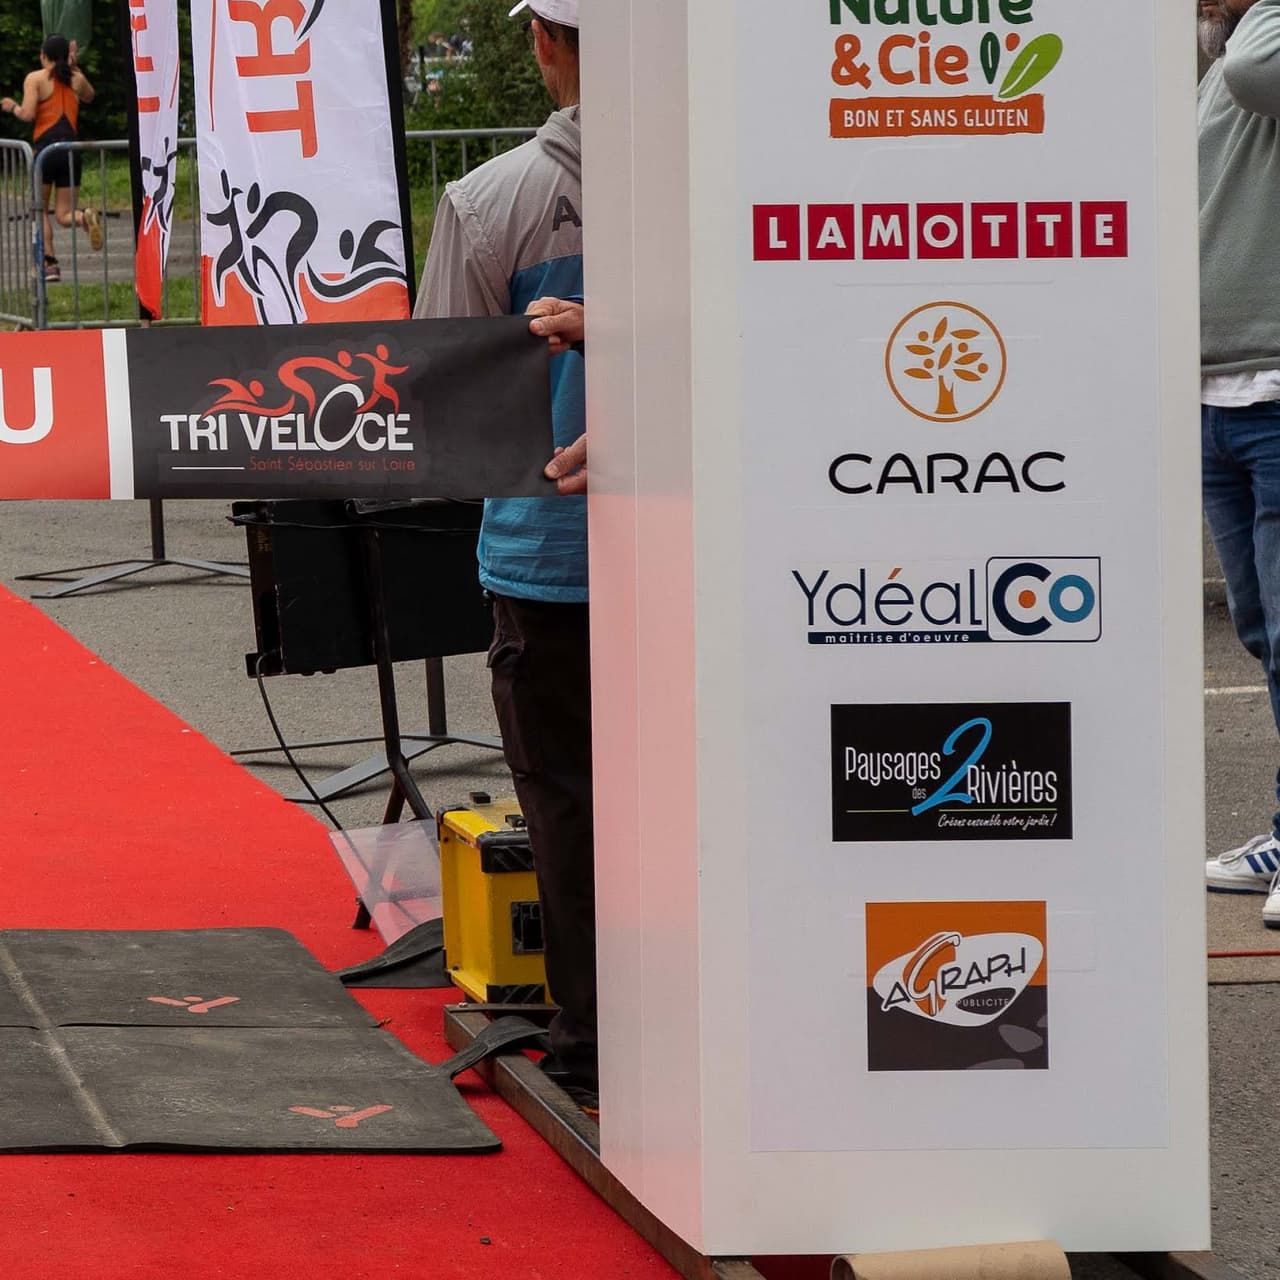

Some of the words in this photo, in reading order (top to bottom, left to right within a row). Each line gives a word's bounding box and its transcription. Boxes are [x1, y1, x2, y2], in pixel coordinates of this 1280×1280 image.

[844, 110, 879, 127] BON
[886, 110, 904, 127] ET
[911, 109, 957, 127] SANS
[964, 109, 1028, 126] GLUTEN
[768, 214, 1113, 248] LAMOTTE
[160, 413, 228, 451] TRI
[240, 383, 414, 451] VELOCE
[250, 456, 281, 470] Saint
[288, 456, 352, 471] Sébastien
[359, 461, 376, 470] sur
[383, 457, 416, 470] Loire
[829, 452, 1065, 494] CARAC
[846, 747, 940, 786] Paysages
[912, 717, 992, 816] 2
[968, 760, 1057, 803] Rivières
[912, 787, 927, 800] des
